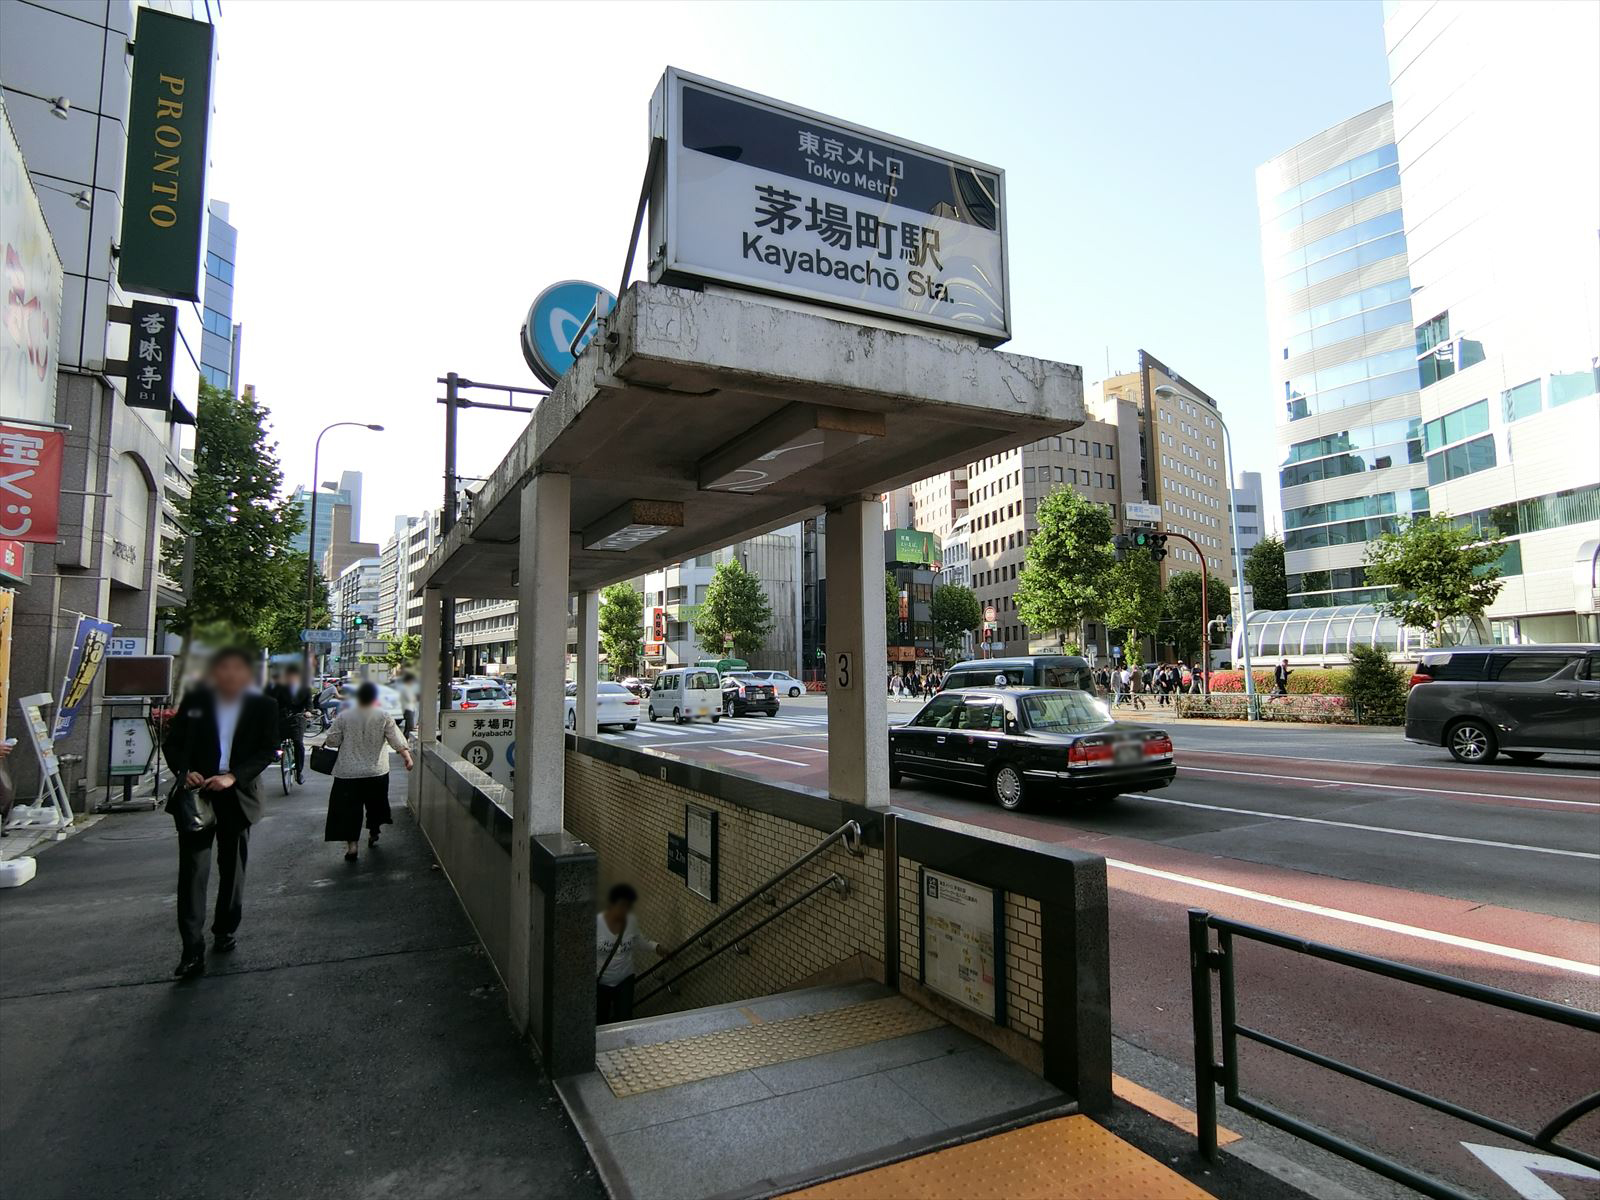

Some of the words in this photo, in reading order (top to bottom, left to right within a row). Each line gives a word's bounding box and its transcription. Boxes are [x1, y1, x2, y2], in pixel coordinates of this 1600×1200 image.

[149, 72, 185, 228] PRONTO
[798, 130, 904, 180] 東京メトロ
[804, 158, 850, 186] Tokyo
[854, 173, 899, 198] Metro
[754, 185, 944, 273] 茅場町駅
[742, 231, 900, 292] Kayabachō
[907, 270, 955, 304] Sta.
[137, 312, 166, 390] 香味亭
[838, 654, 849, 687] 3
[448, 720, 457, 728] 3
[471, 729, 513, 739] Kayabachō
[473, 718, 514, 730] 茅場町
[472, 756, 484, 764] 12
[473, 748, 481, 756] H
